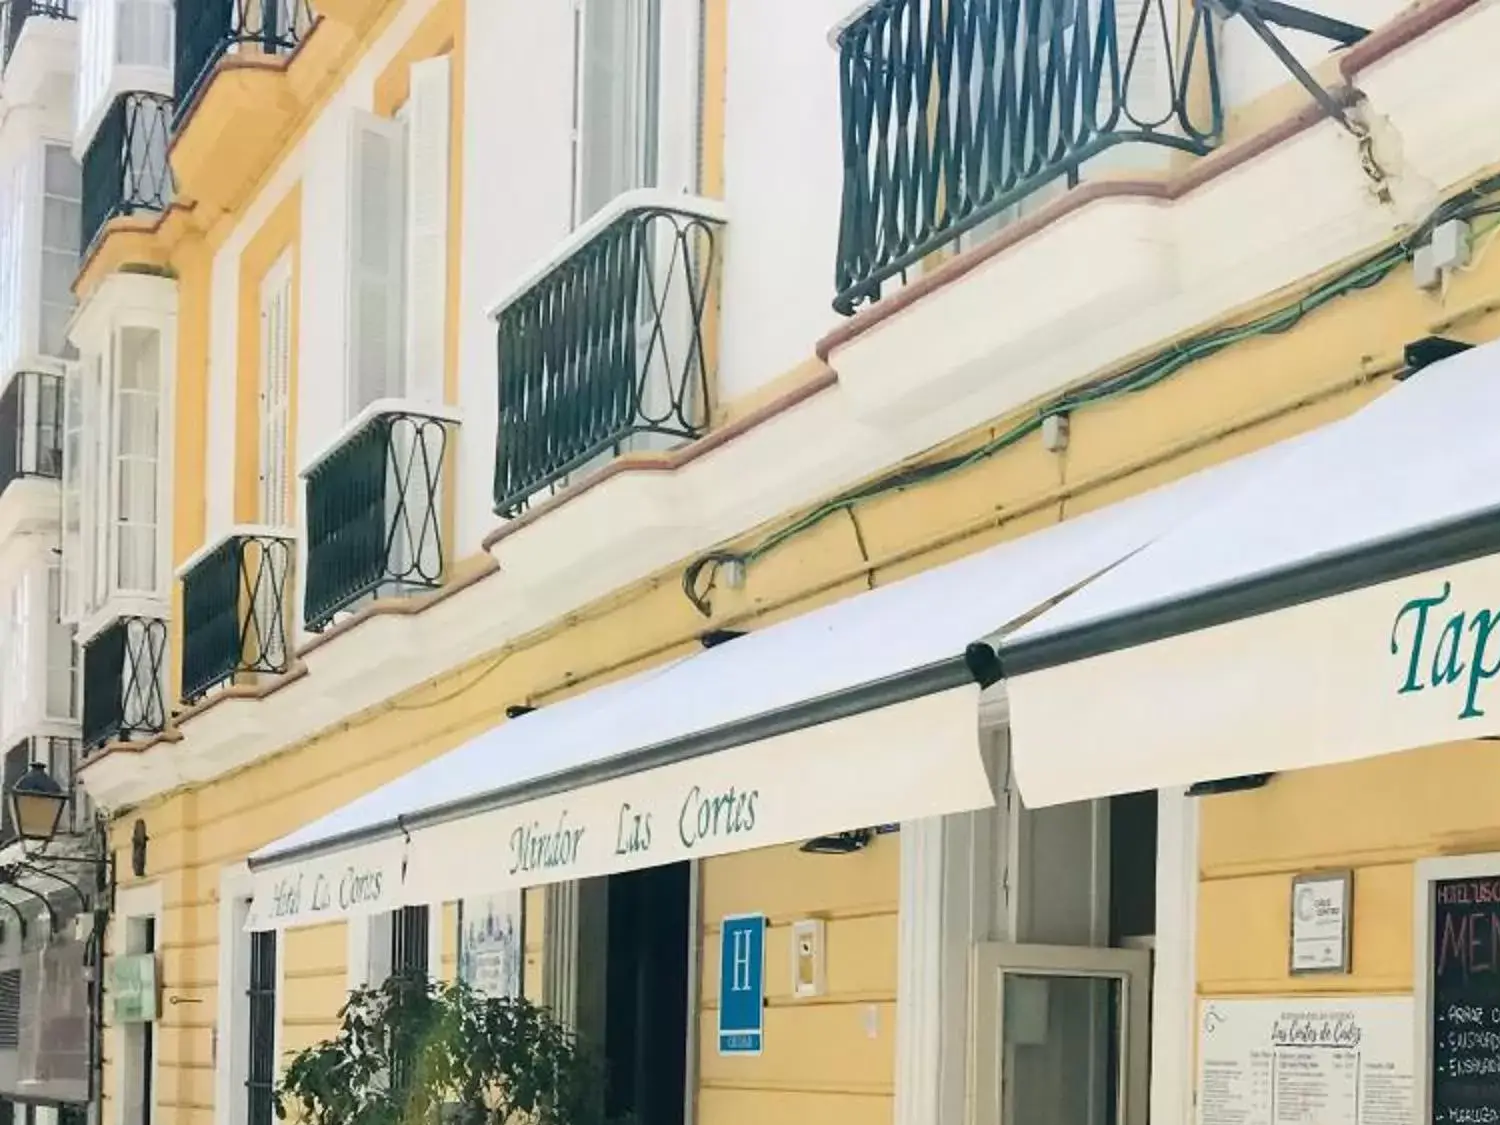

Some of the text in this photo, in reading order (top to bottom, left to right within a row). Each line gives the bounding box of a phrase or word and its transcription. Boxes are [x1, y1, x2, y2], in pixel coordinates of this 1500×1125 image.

[509, 785, 759, 875] Mirador Las Cortes
[731, 929, 753, 991] H
